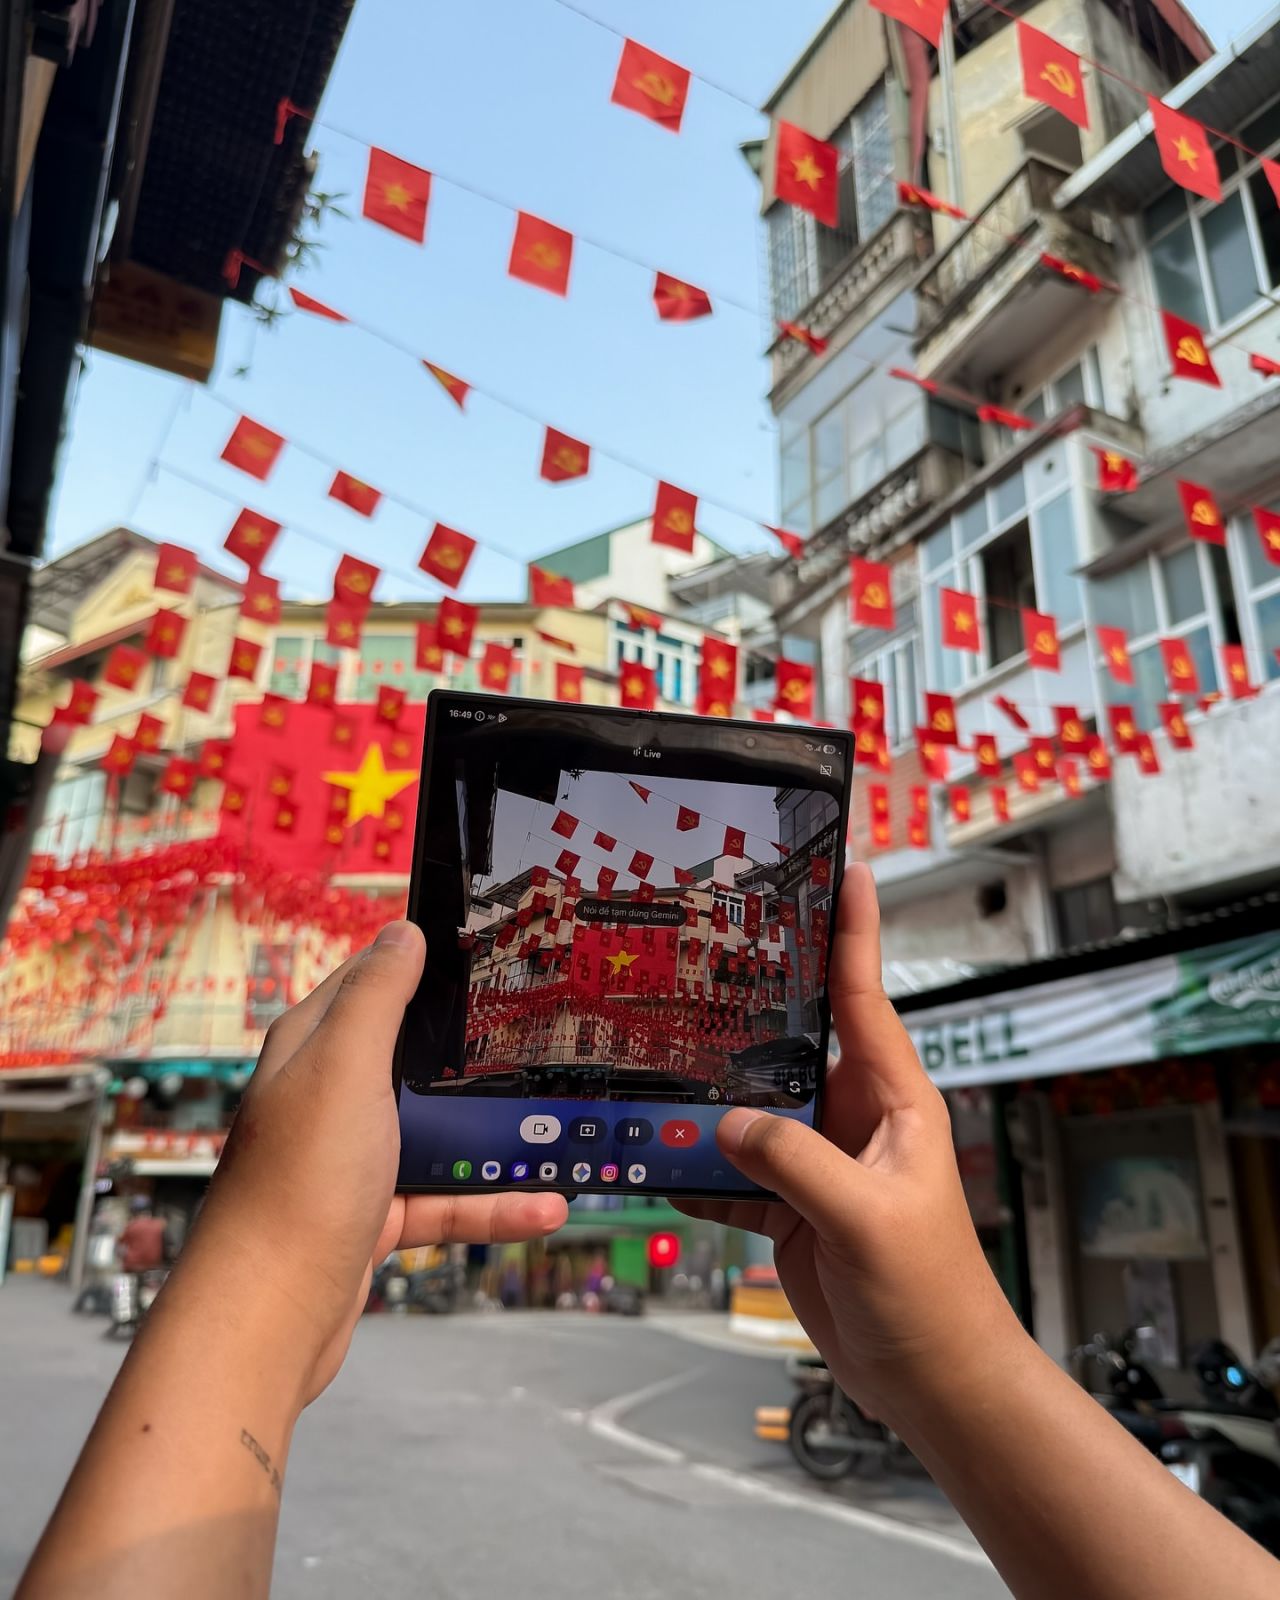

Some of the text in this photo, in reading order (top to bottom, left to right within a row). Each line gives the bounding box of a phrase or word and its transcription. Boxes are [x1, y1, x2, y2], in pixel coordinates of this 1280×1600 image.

[449, 709, 472, 719] 16:49
[644, 749, 661, 759] Live
[583, 905, 597, 915] Nói
[612, 908, 627, 918] tạm
[651, 909, 680, 920] Gemini
[923, 1009, 1029, 1070] BELL
